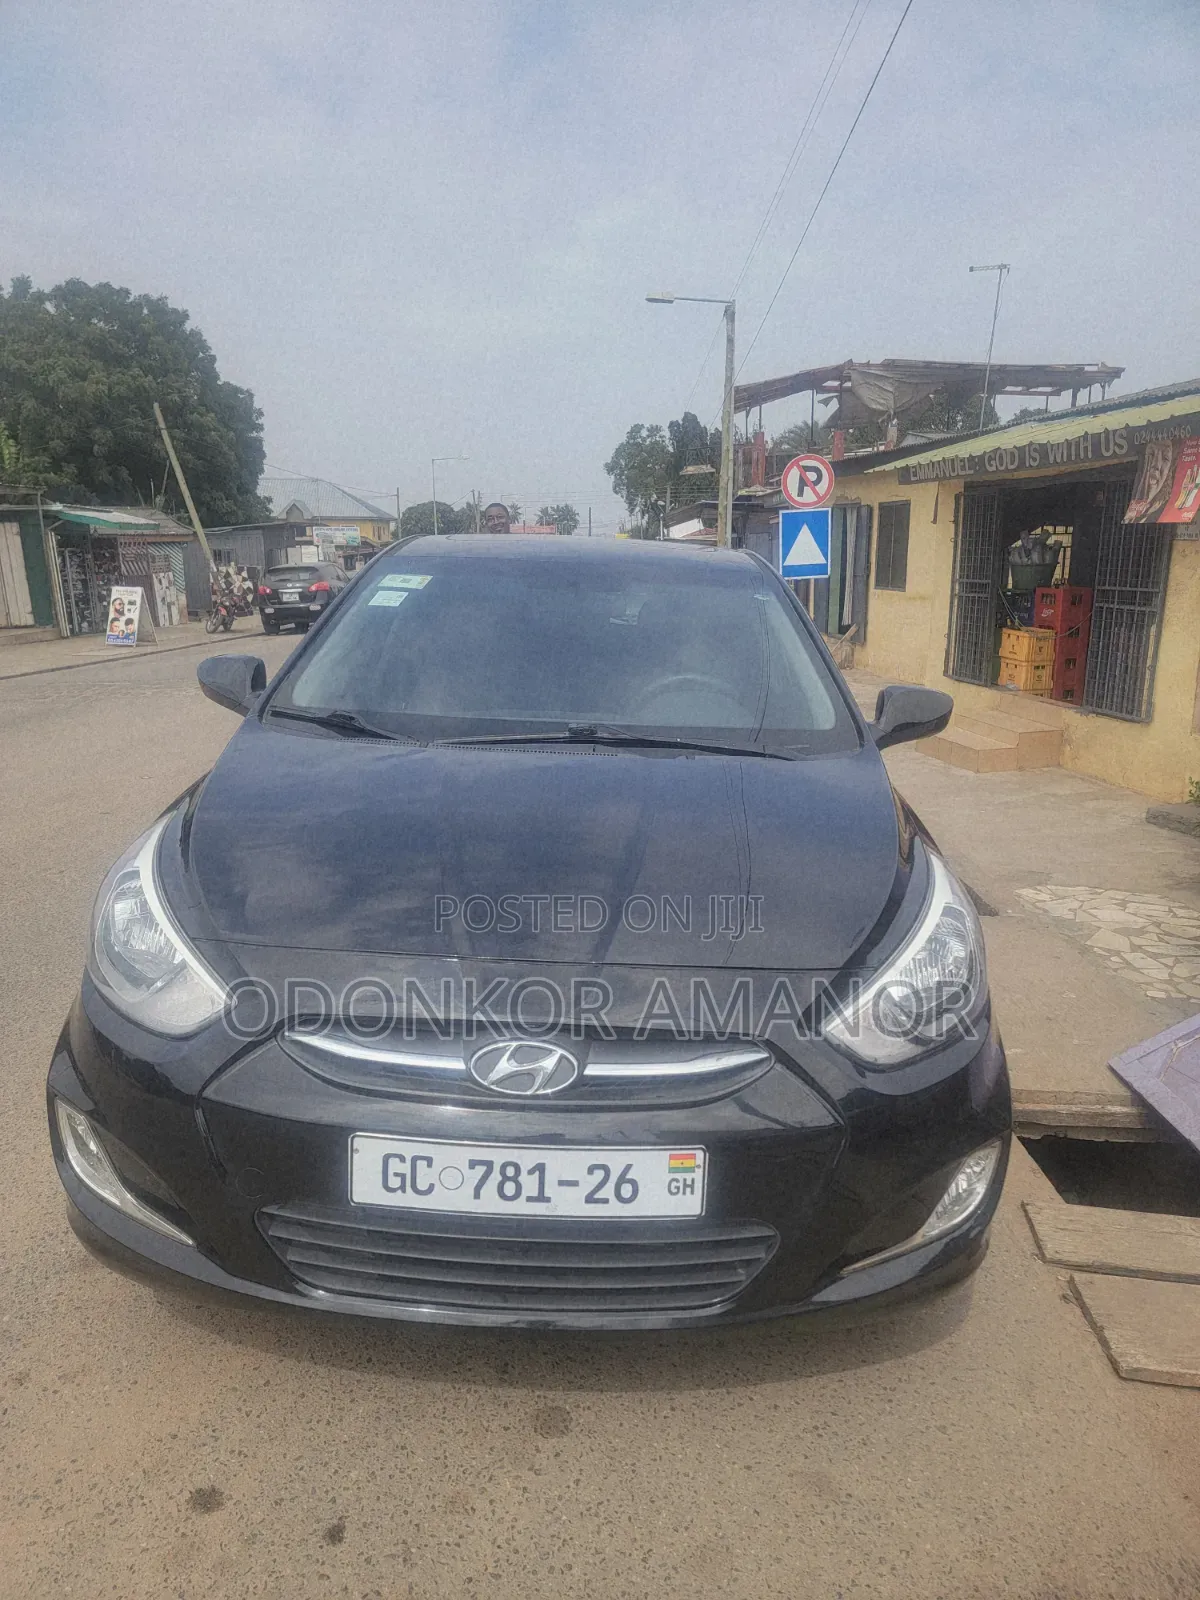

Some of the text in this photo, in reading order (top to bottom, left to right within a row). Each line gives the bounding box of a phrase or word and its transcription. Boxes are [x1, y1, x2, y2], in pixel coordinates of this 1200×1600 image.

[984, 447, 1019, 472] GOD
[1025, 443, 1040, 468] IS
[1046, 433, 1092, 464] WITH
[1100, 429, 1128, 457] US
[797, 465, 823, 497] P
[667, 1177, 695, 1196] GH
